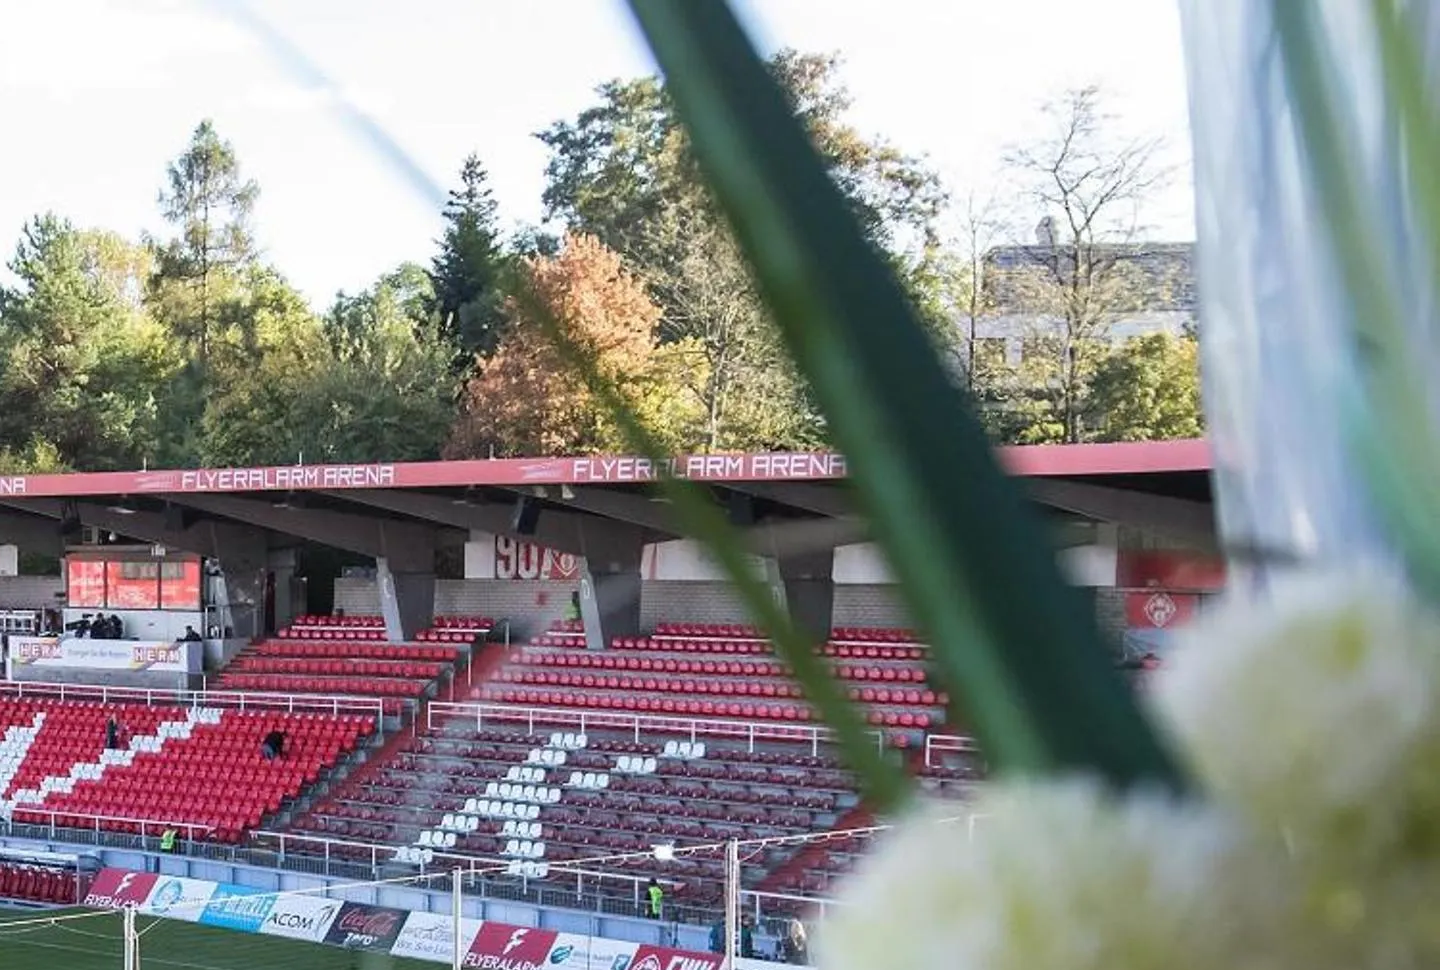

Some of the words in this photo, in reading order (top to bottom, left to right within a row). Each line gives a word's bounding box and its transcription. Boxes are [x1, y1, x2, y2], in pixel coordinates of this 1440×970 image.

[751, 452, 847, 477] ARENA
[181, 467, 317, 489] FLYERALARM
[323, 465, 394, 486] ARENA
[266, 912, 313, 931] ACOM
